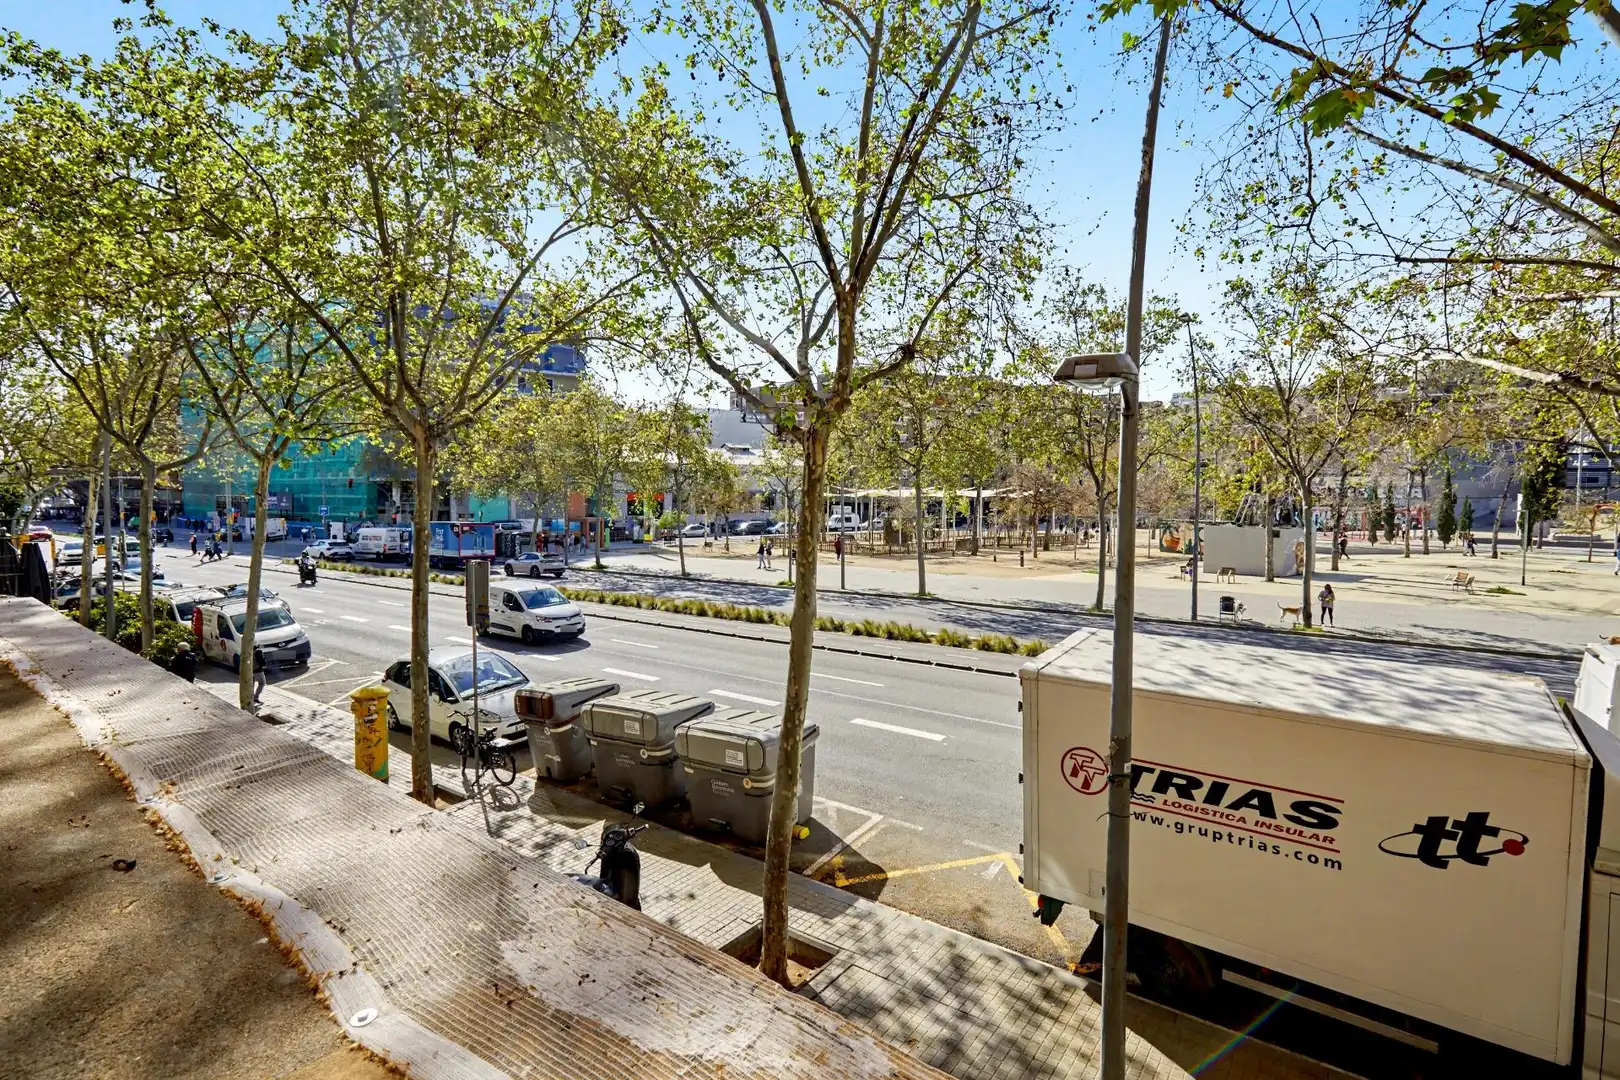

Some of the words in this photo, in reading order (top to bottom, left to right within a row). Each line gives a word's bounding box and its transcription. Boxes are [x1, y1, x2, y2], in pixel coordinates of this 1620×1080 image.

[1130, 763, 1343, 831] TRIAS
[1162, 798, 1248, 825] LOGISTICA
[1254, 819, 1336, 846] INSULAR
[1131, 811, 1343, 871] ww.gruptrias.com
